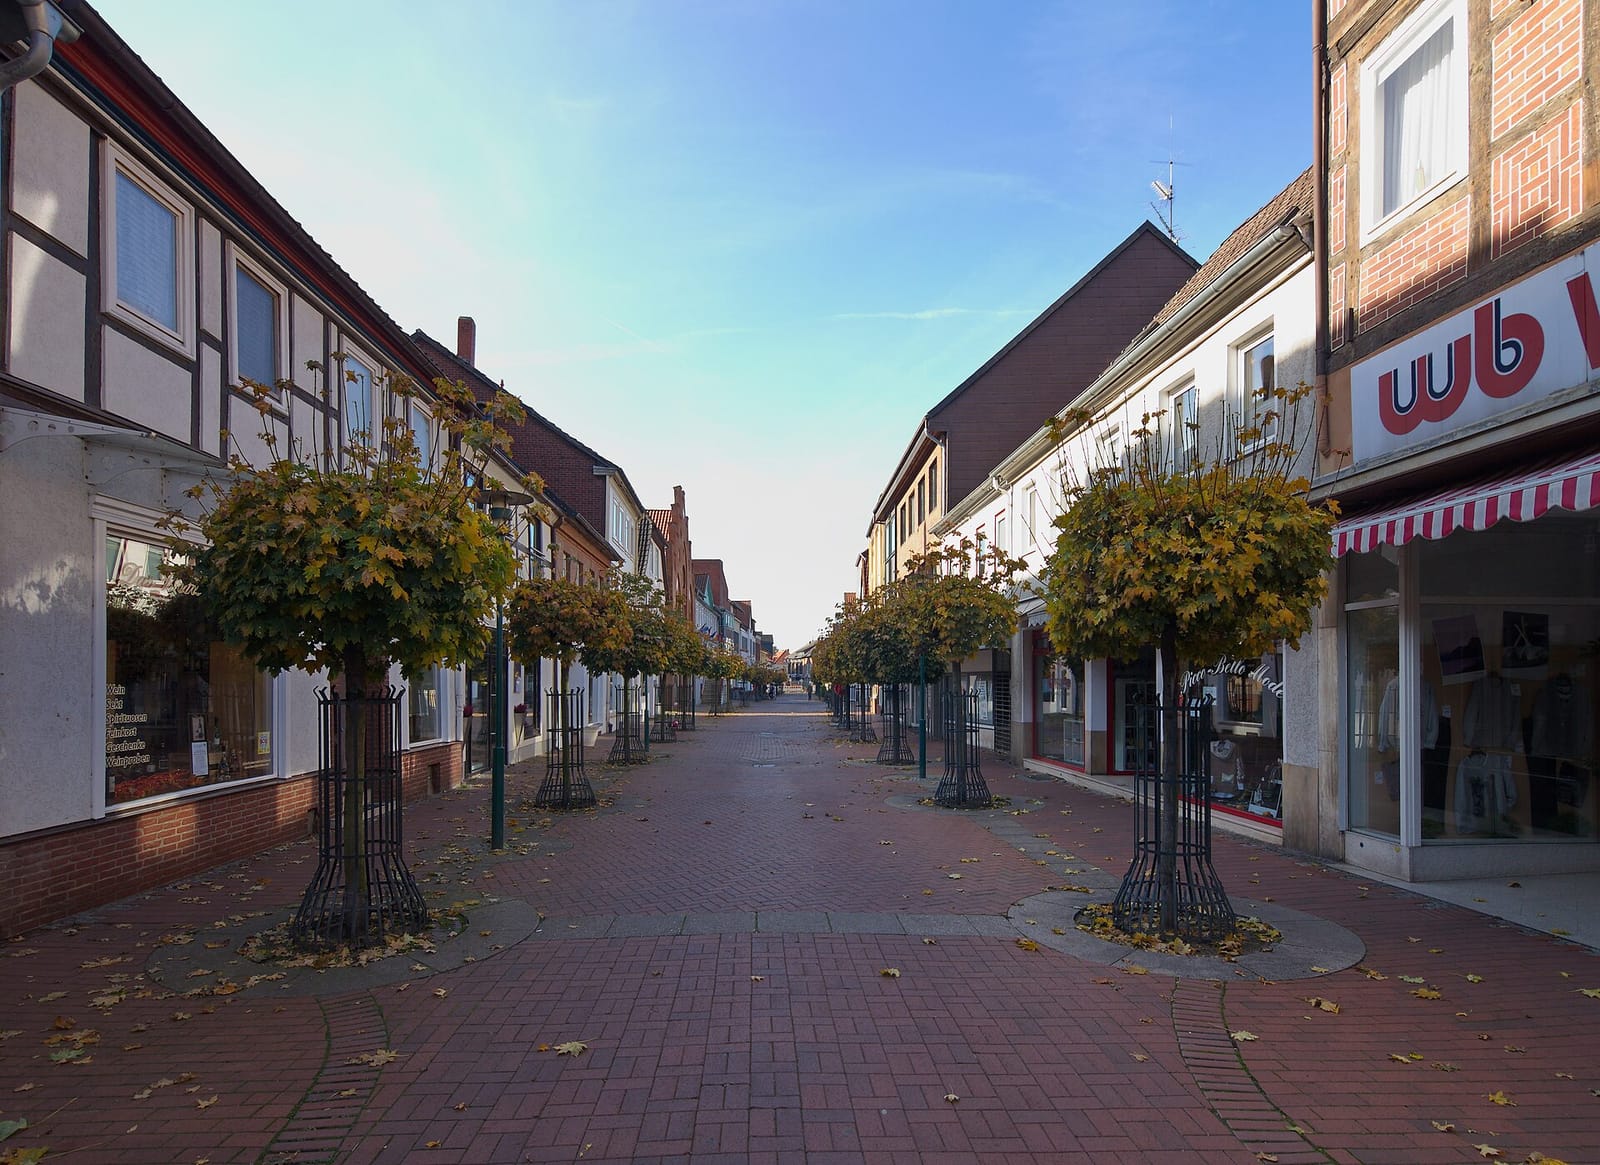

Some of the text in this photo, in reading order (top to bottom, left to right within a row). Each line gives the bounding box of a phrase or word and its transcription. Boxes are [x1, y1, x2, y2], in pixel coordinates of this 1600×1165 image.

[1378, 296, 1545, 436] wb
[1248, 663, 1284, 698] Mode
[106, 683, 126, 695] Wein
[106, 698, 124, 710] Sekt
[106, 713, 148, 726] Spirituosen
[106, 727, 137, 739] Feinkost
[106, 739, 146, 753] Geschenke
[106, 752, 151, 769] Weinproben
